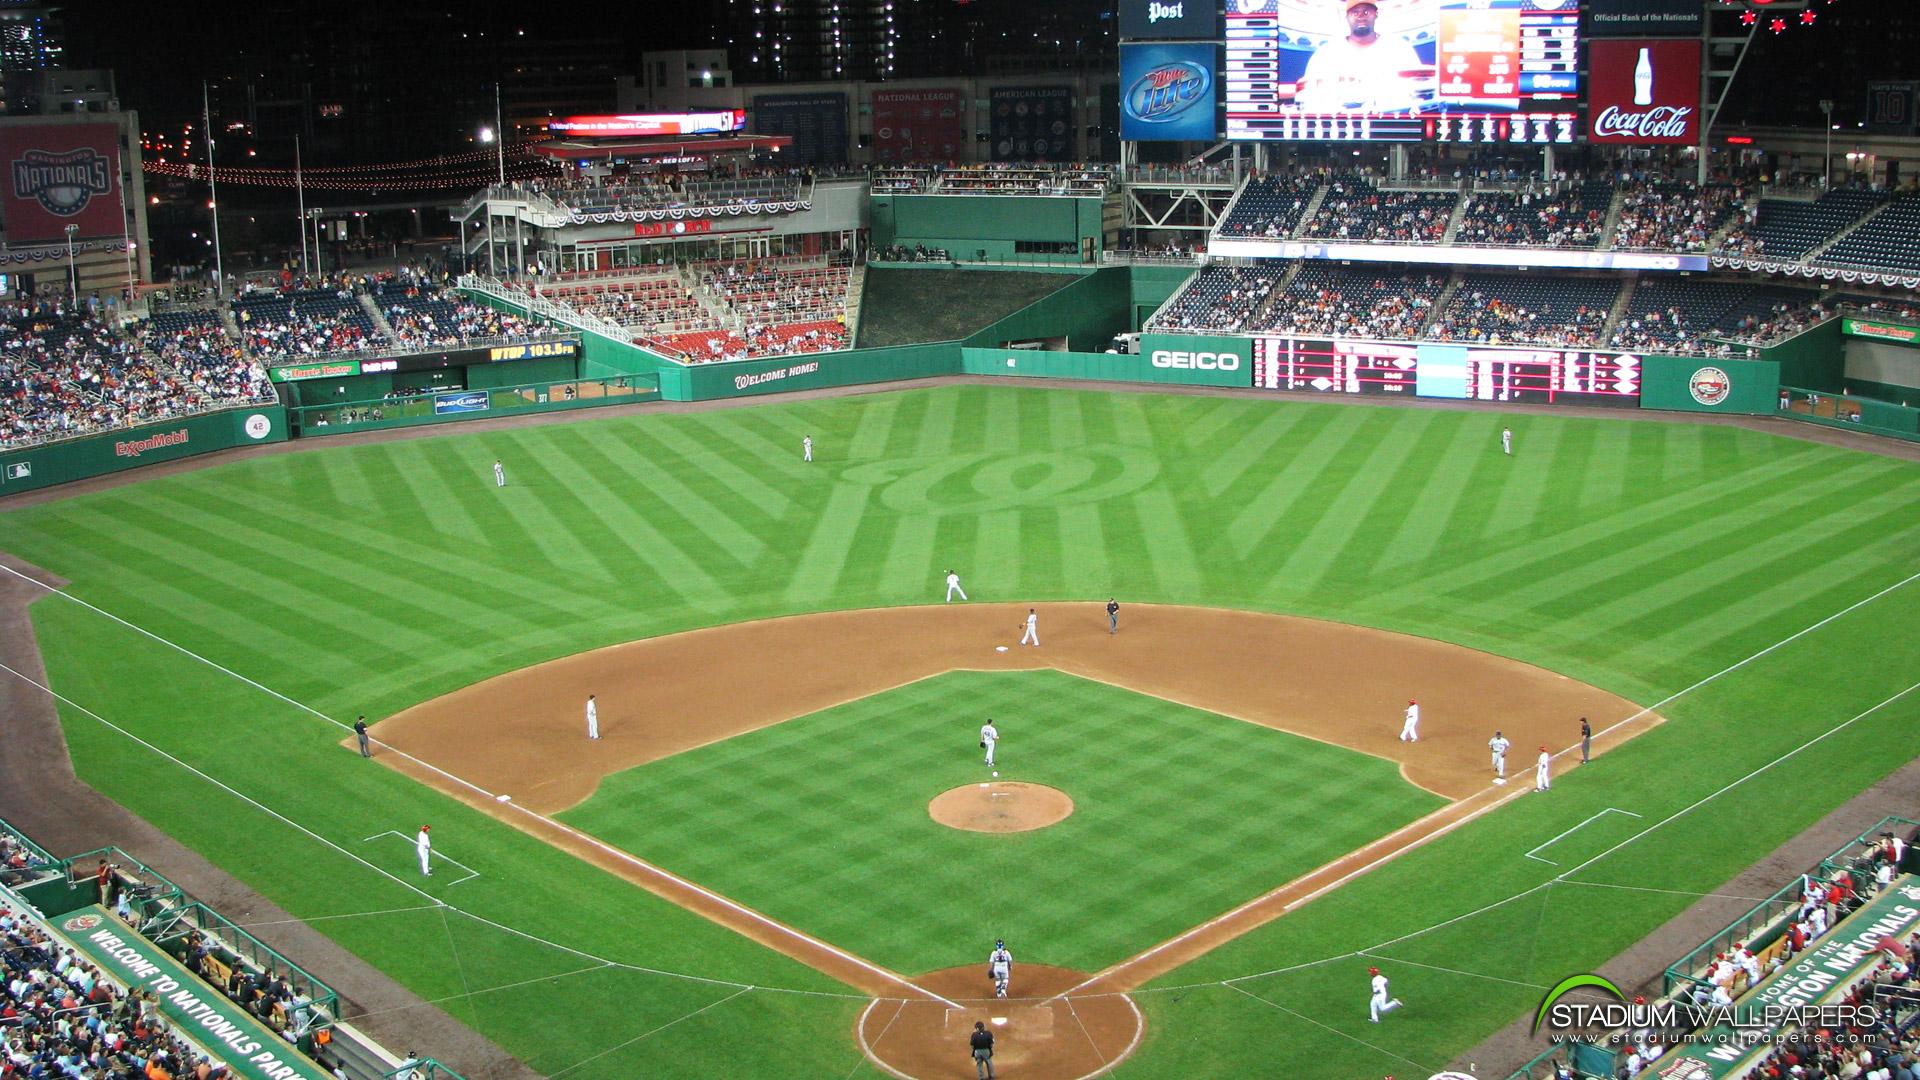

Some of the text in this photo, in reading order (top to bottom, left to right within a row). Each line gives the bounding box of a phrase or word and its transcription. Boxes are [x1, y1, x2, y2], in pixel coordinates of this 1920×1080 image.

[1149, 2, 1183, 24] Post
[1594, 13, 1698, 22] Official Bank of the Nationals
[878, 92, 955, 102] NATIONAL LEAGUE
[994, 89, 1068, 99] AMERICAN LEAGUE
[1141, 78, 1200, 114] Lite
[1595, 105, 1692, 137] Coca-Cola
[19, 161, 106, 193] NATIONALS
[490, 346, 526, 360] WTOP
[1151, 350, 1239, 371] GEICO
[788, 362, 818, 377] HOME!
[252, 422, 264, 431] 42
[116, 429, 189, 457] ExxonMobil
[1823, 905, 1919, 972] NATIONALS
[1756, 940, 1844, 1003] HOME OF THE
[89, 929, 161, 979] WELCOME
[150, 973, 180, 994] TO
[168, 989, 263, 1055] NATIONALS
